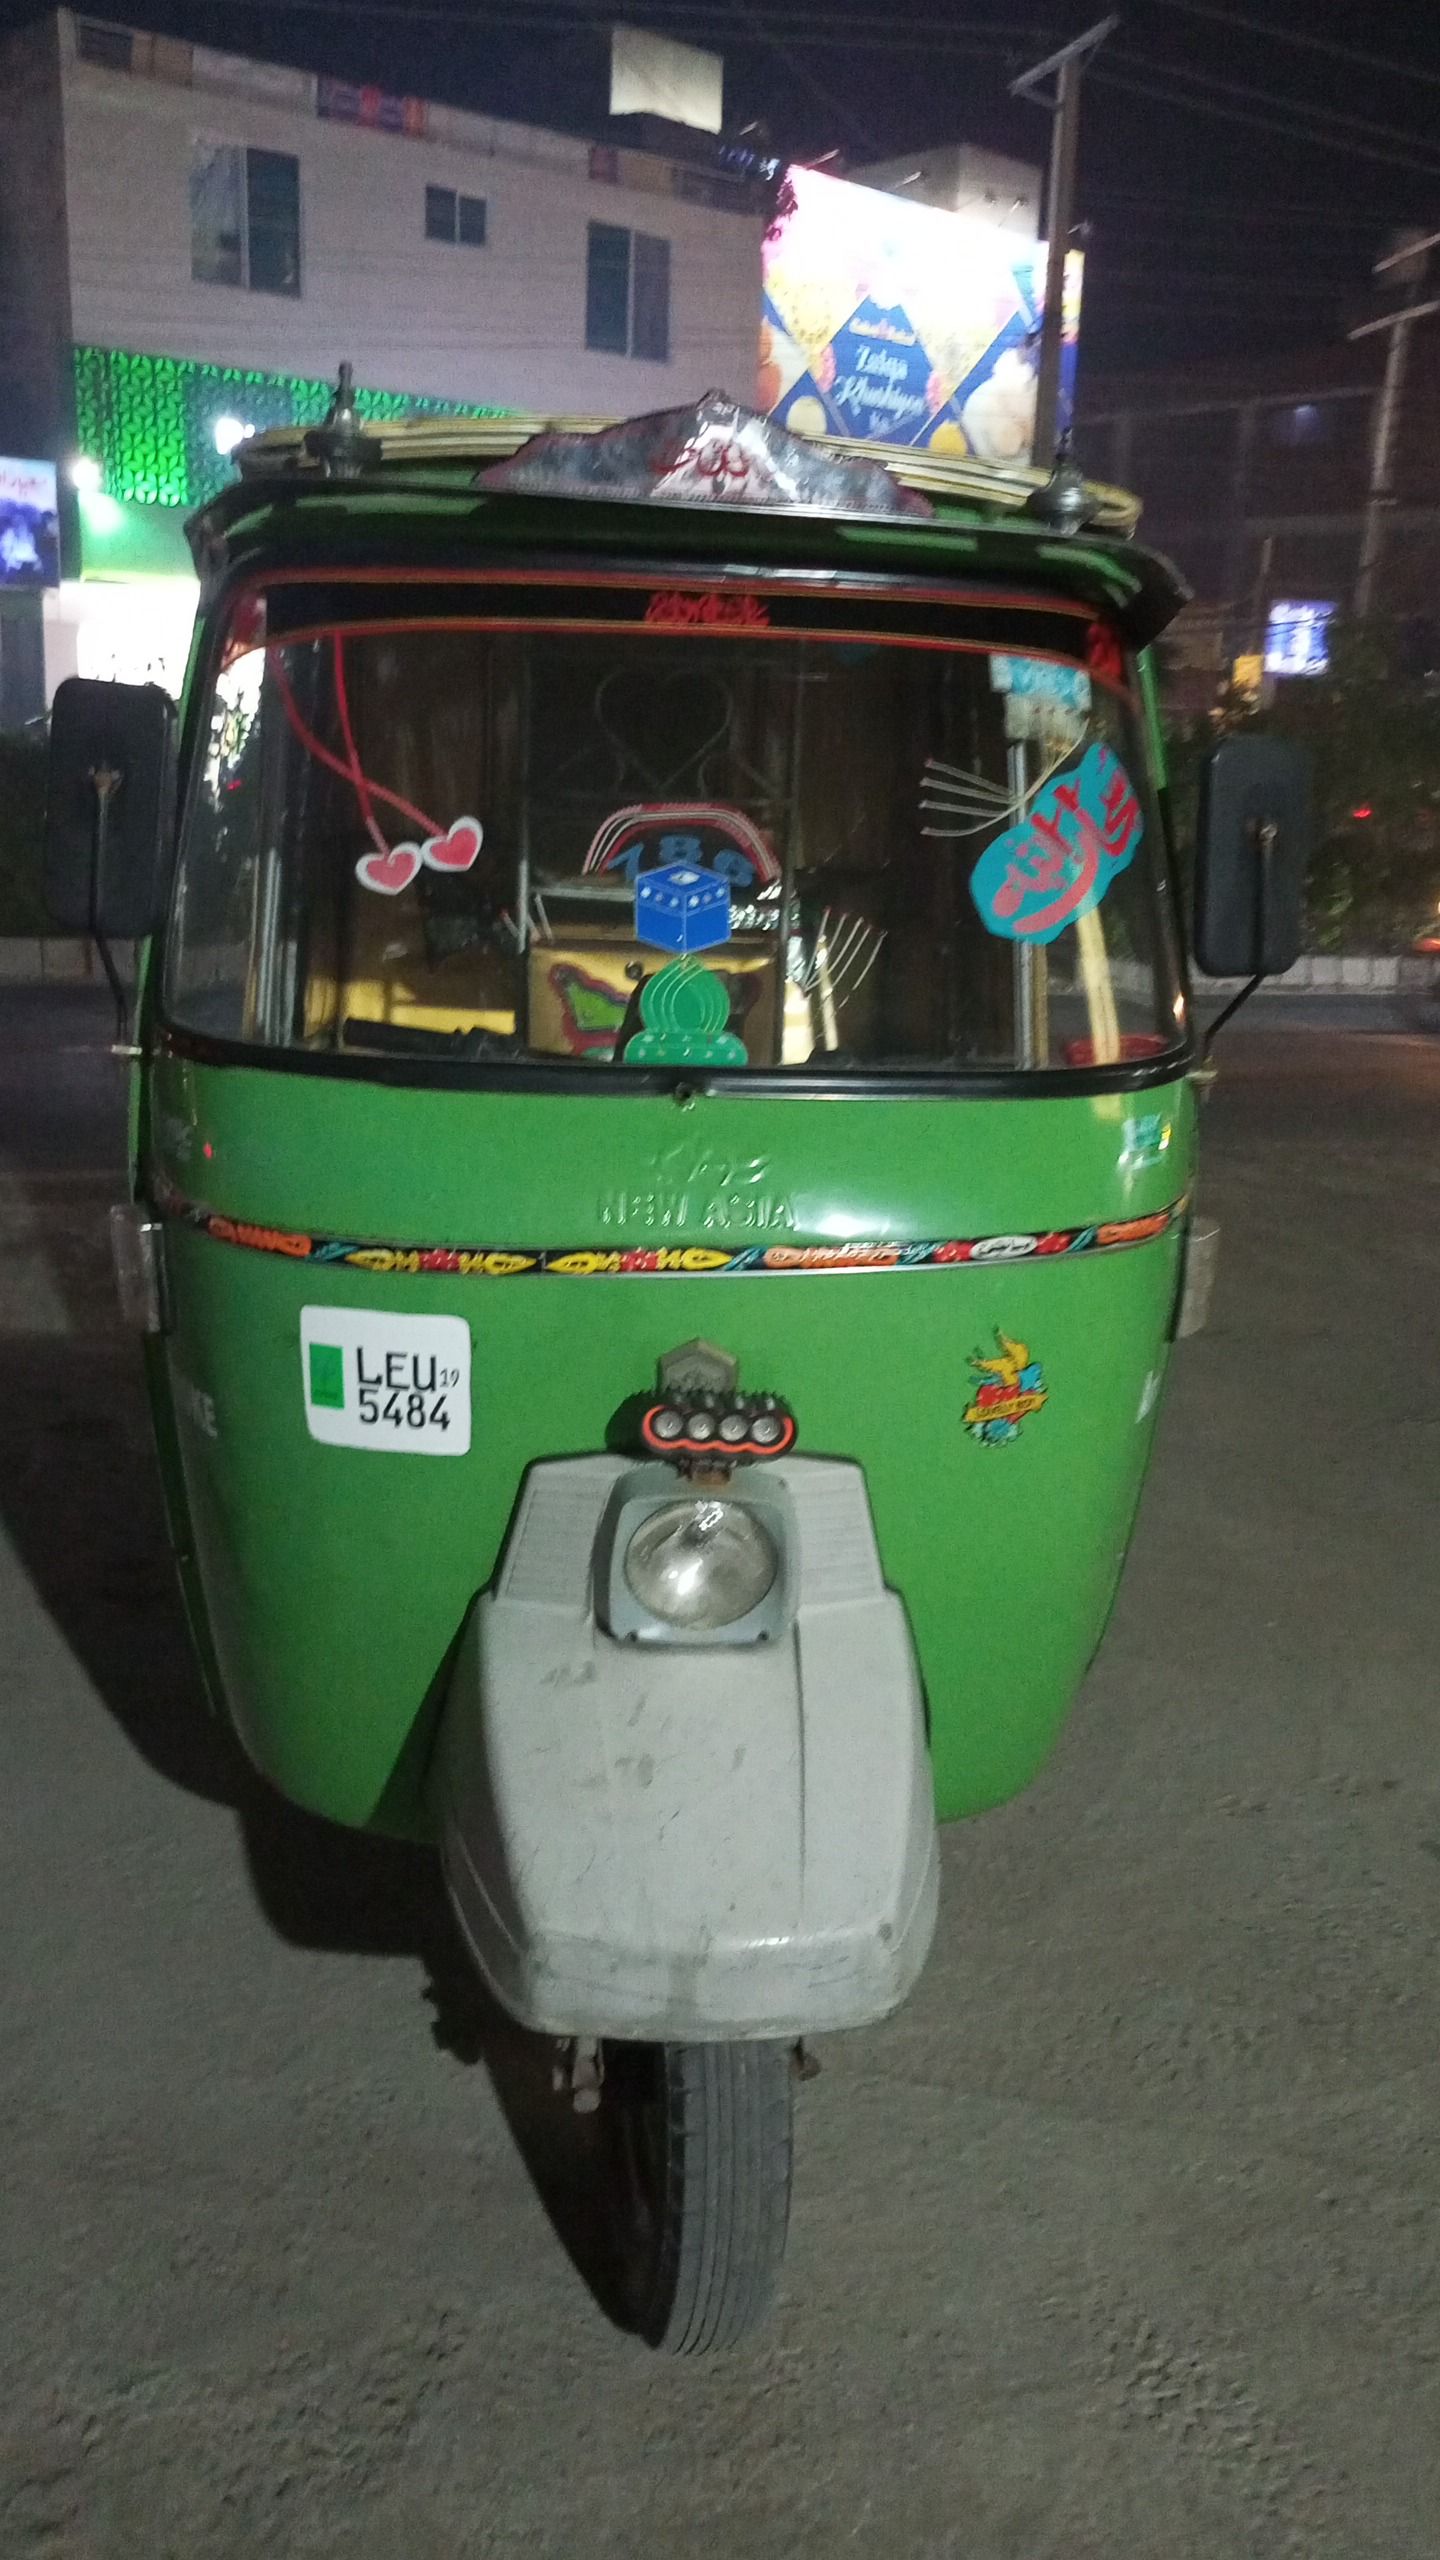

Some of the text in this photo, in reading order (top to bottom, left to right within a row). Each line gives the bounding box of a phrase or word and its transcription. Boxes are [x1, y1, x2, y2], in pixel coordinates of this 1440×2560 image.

[600, 1191, 801, 1232] NEW ASIA
[356, 1346, 460, 1393] LEU 19
[358, 1387, 451, 1432] 5484
